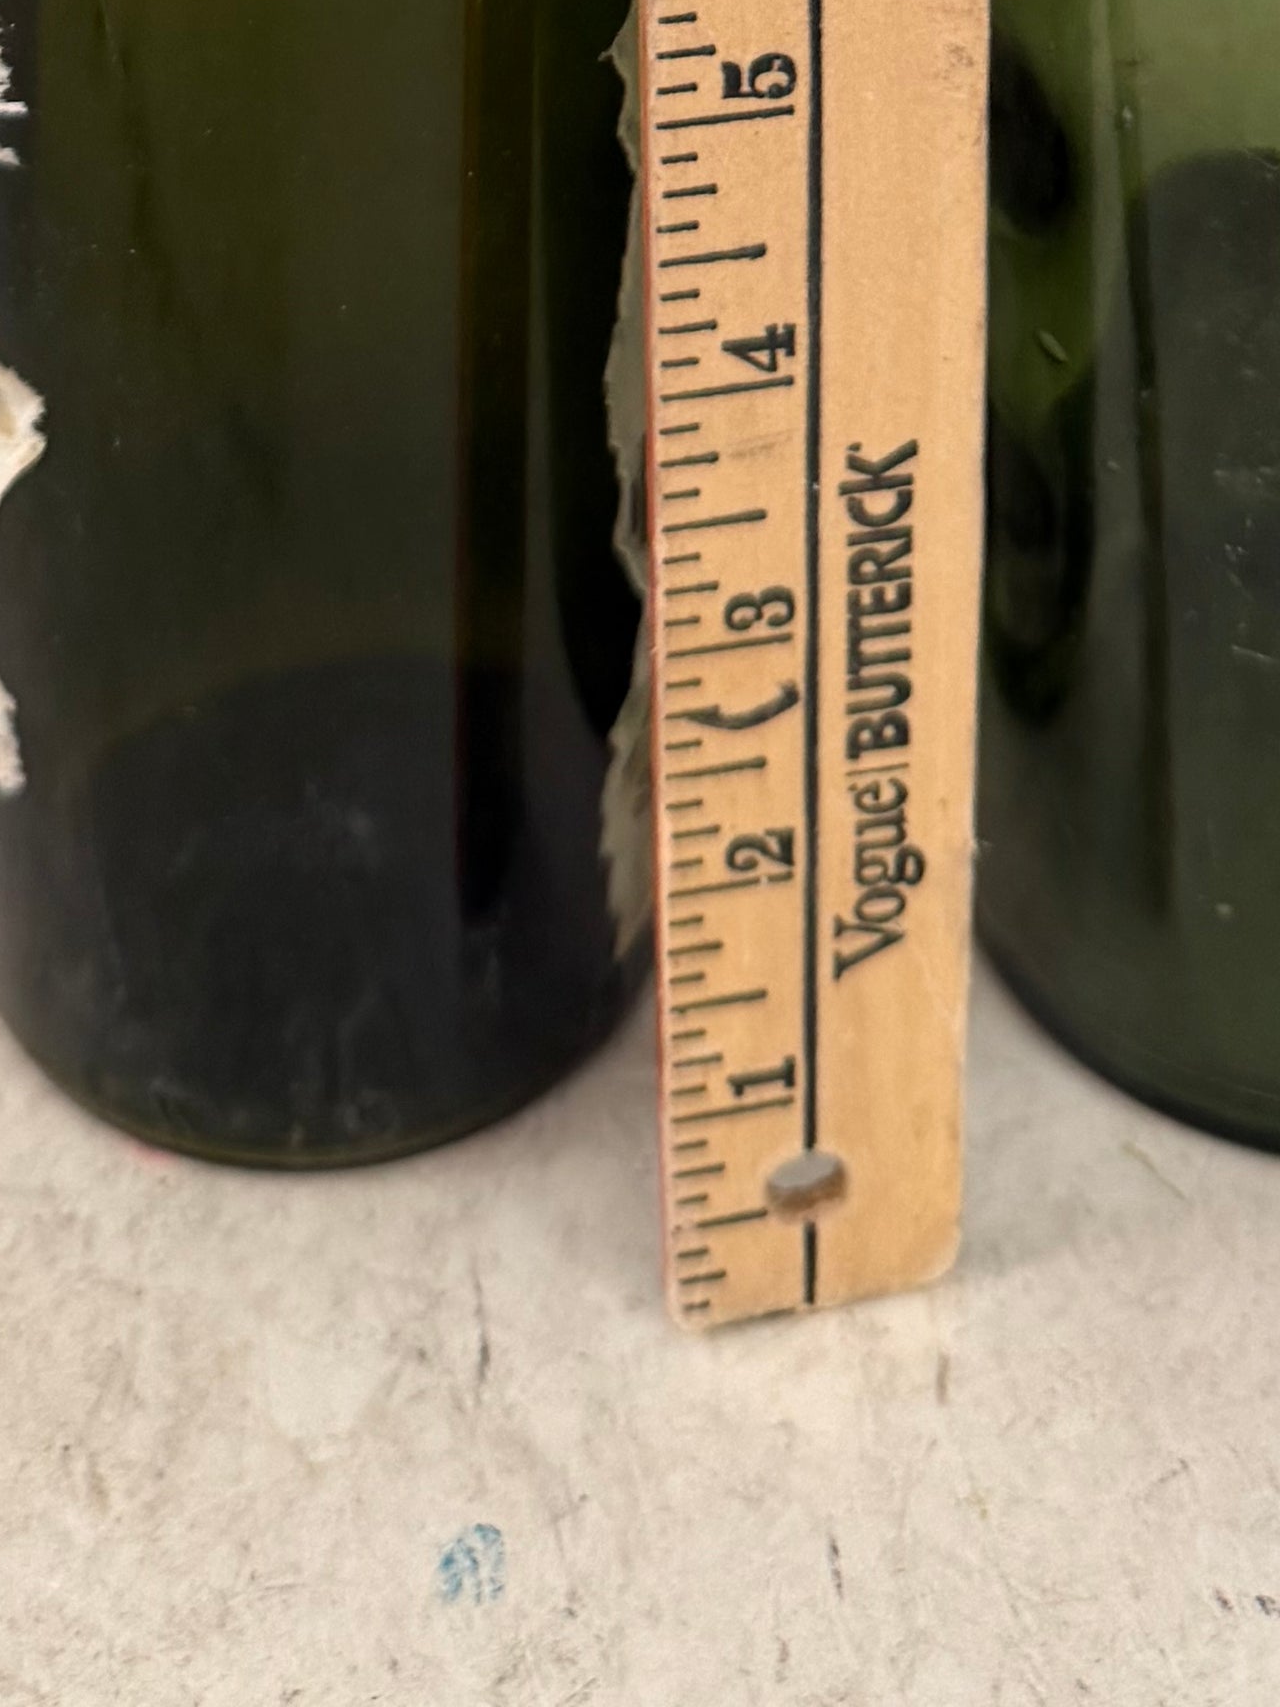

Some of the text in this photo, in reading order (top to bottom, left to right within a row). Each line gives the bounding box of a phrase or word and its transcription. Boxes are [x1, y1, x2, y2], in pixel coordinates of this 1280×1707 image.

[720, 51, 798, 100] 5
[721, 321, 796, 374] 4
[723, 585, 796, 633] 3
[832, 439, 926, 981] Vogue BUTTERICK
[725, 827, 796, 874] 2
[728, 1055, 797, 1098] 1
